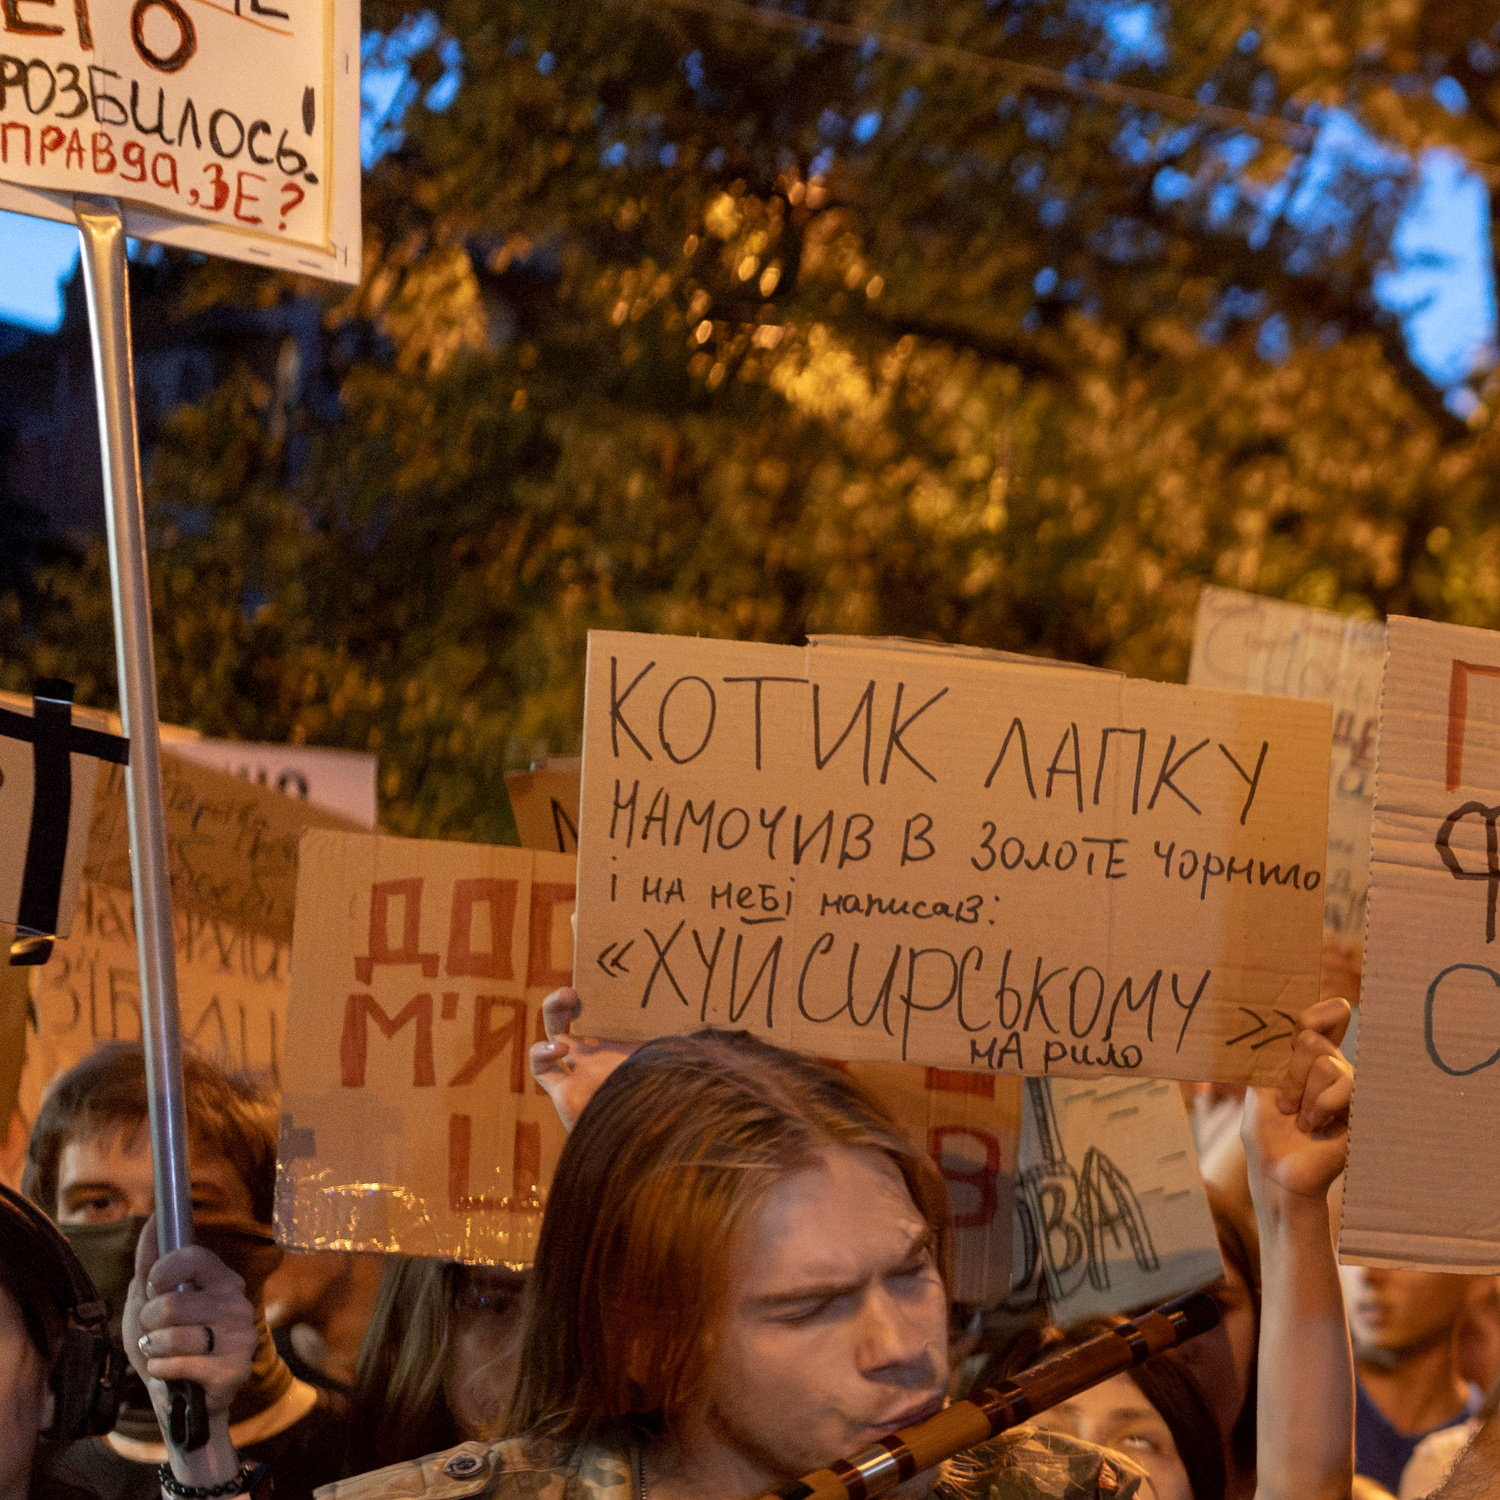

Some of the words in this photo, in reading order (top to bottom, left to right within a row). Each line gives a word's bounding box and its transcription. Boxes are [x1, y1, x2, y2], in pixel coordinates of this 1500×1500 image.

[610, 656, 949, 785] КОТИК
[985, 717, 1269, 825] ЛАПКУ
[609, 779, 874, 869] НАМОЧИВ
